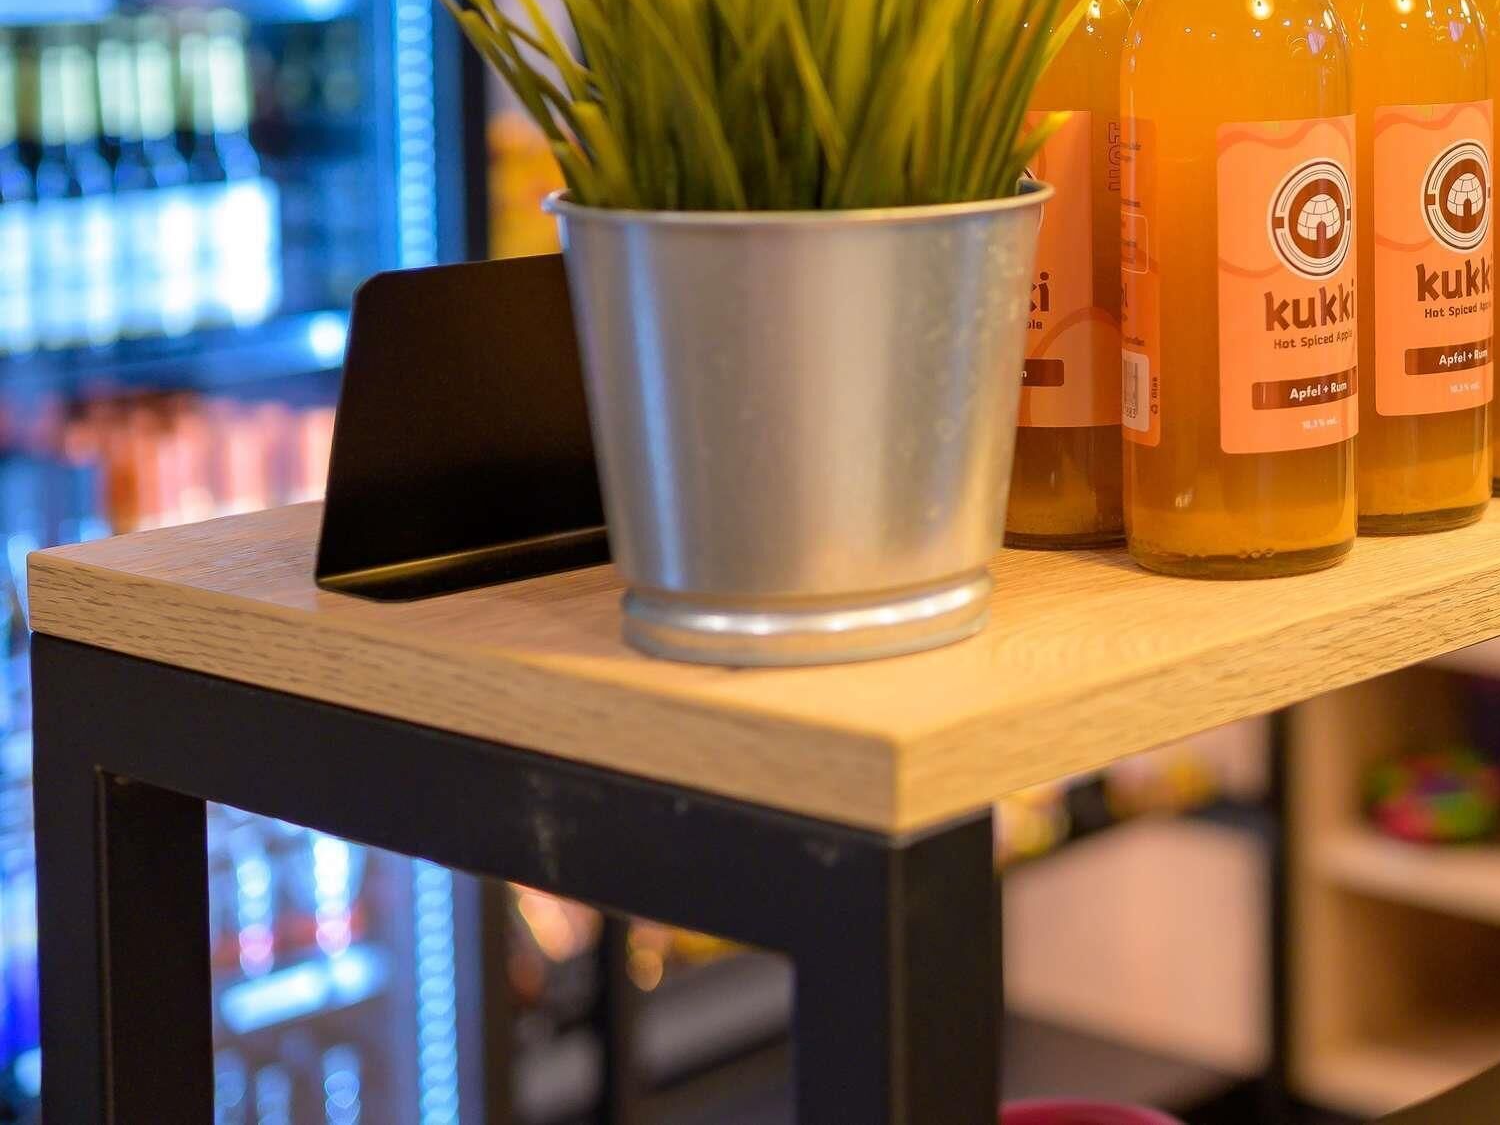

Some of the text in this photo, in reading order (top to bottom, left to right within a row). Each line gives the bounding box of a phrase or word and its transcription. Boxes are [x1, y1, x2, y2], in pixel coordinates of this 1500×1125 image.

[1264, 278, 1355, 331] kukki
[1424, 307, 1445, 318] Hot
[1448, 303, 1477, 317] Spiced
[1273, 339, 1297, 350] Hot
[1300, 332, 1335, 350] Spiced
[1439, 351, 1466, 367] Apfel
[1289, 383, 1322, 402] Apfel
[1330, 380, 1348, 393] Rum
